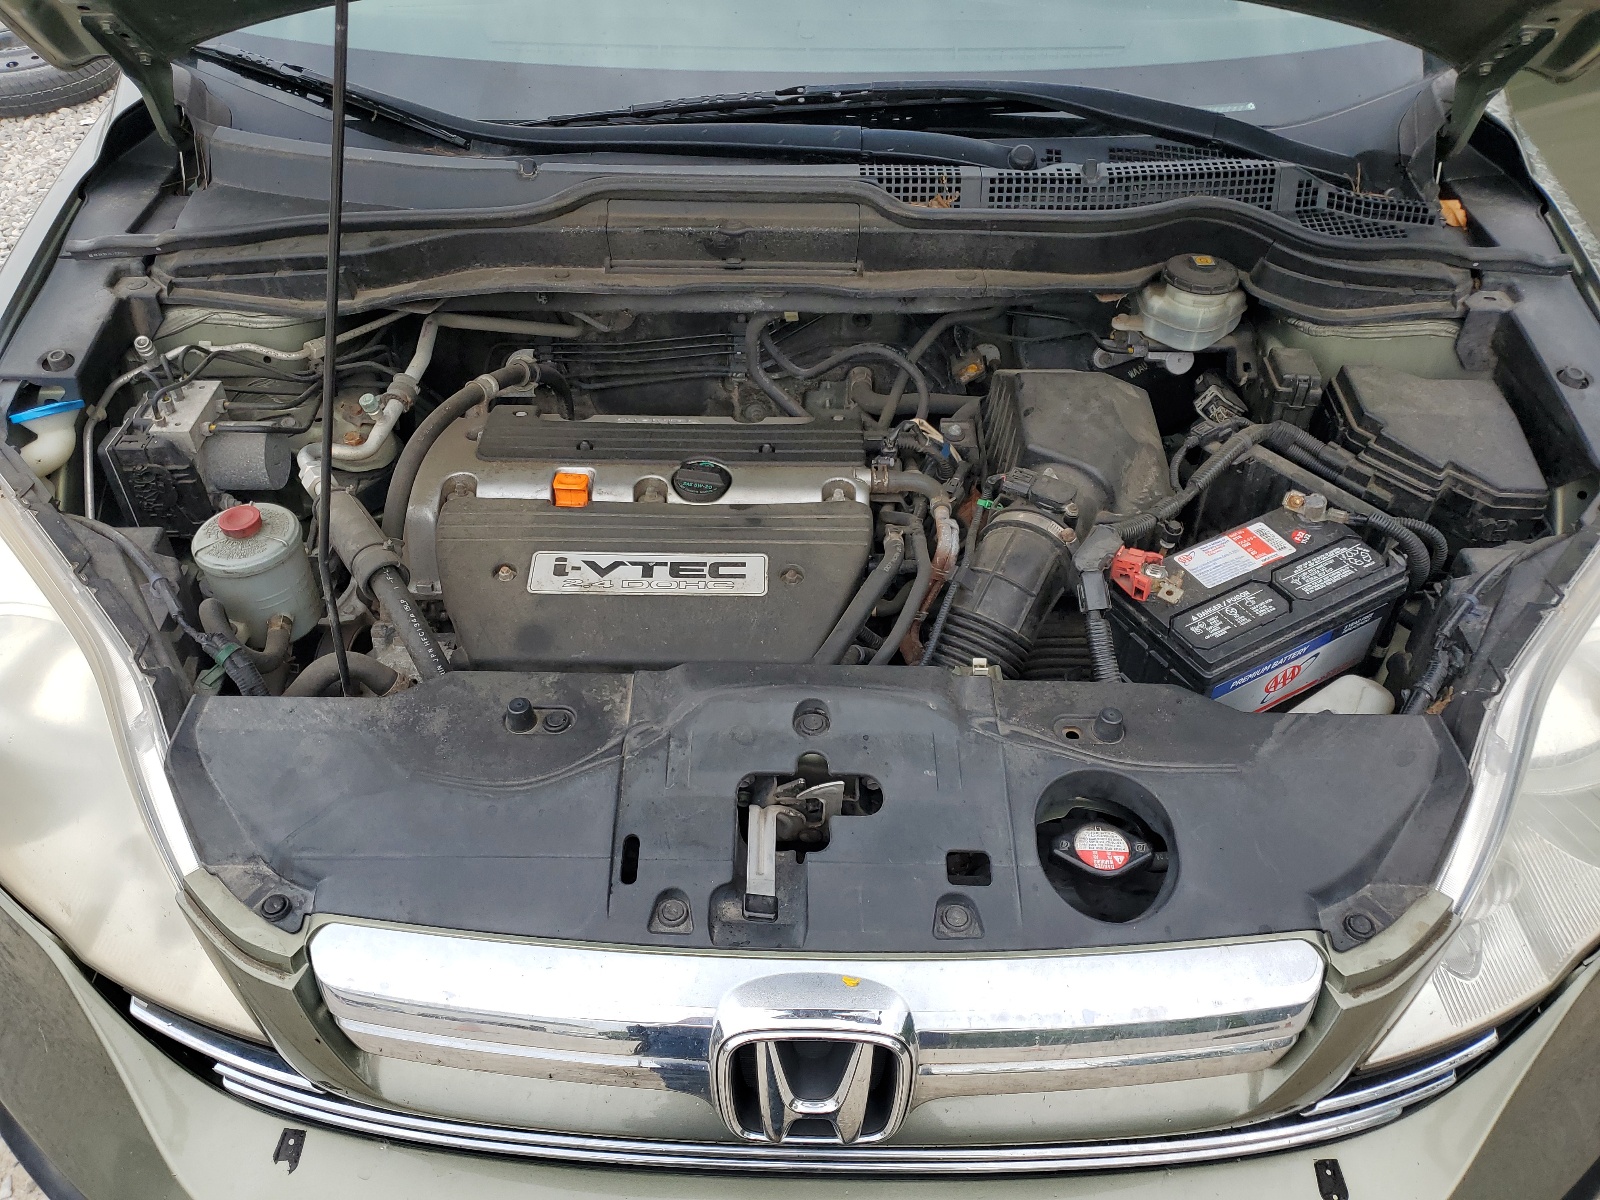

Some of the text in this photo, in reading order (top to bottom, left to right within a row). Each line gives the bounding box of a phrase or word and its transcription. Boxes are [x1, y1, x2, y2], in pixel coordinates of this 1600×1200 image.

[553, 556, 747, 578] i-VTEC
[562, 578, 735, 590] 2.4 DOHC
[1229, 645, 1311, 690] PREMIUM BATTERY
[1265, 665, 1302, 694] AAA
